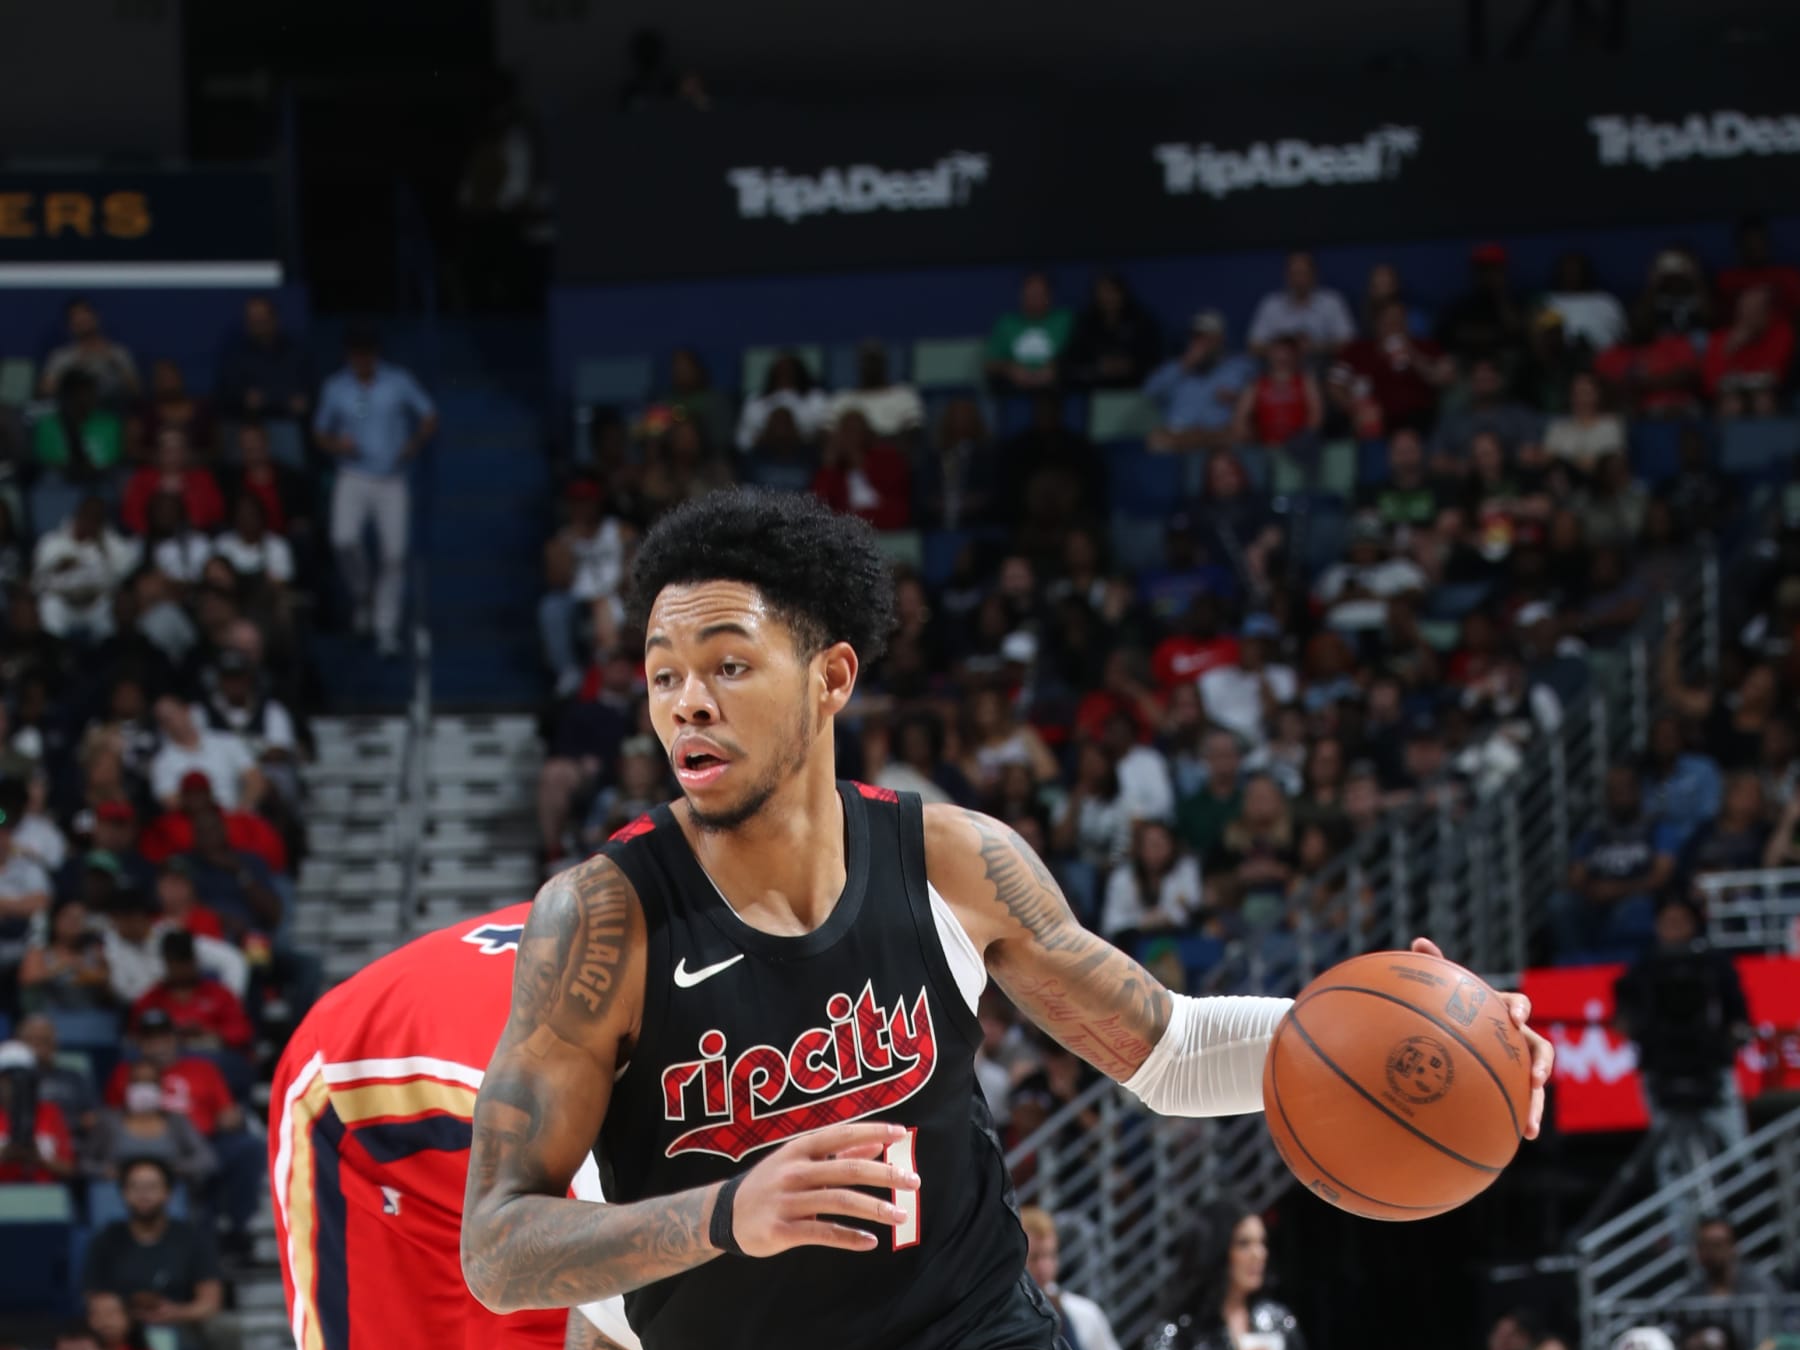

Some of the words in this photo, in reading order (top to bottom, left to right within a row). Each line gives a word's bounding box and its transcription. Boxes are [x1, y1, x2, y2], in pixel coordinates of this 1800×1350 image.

[726, 156, 952, 222] TripADeal
[1153, 130, 1382, 199] TripADeal
[568, 884, 628, 1013] VILLAGE
[661, 978, 938, 1162] ripcity
